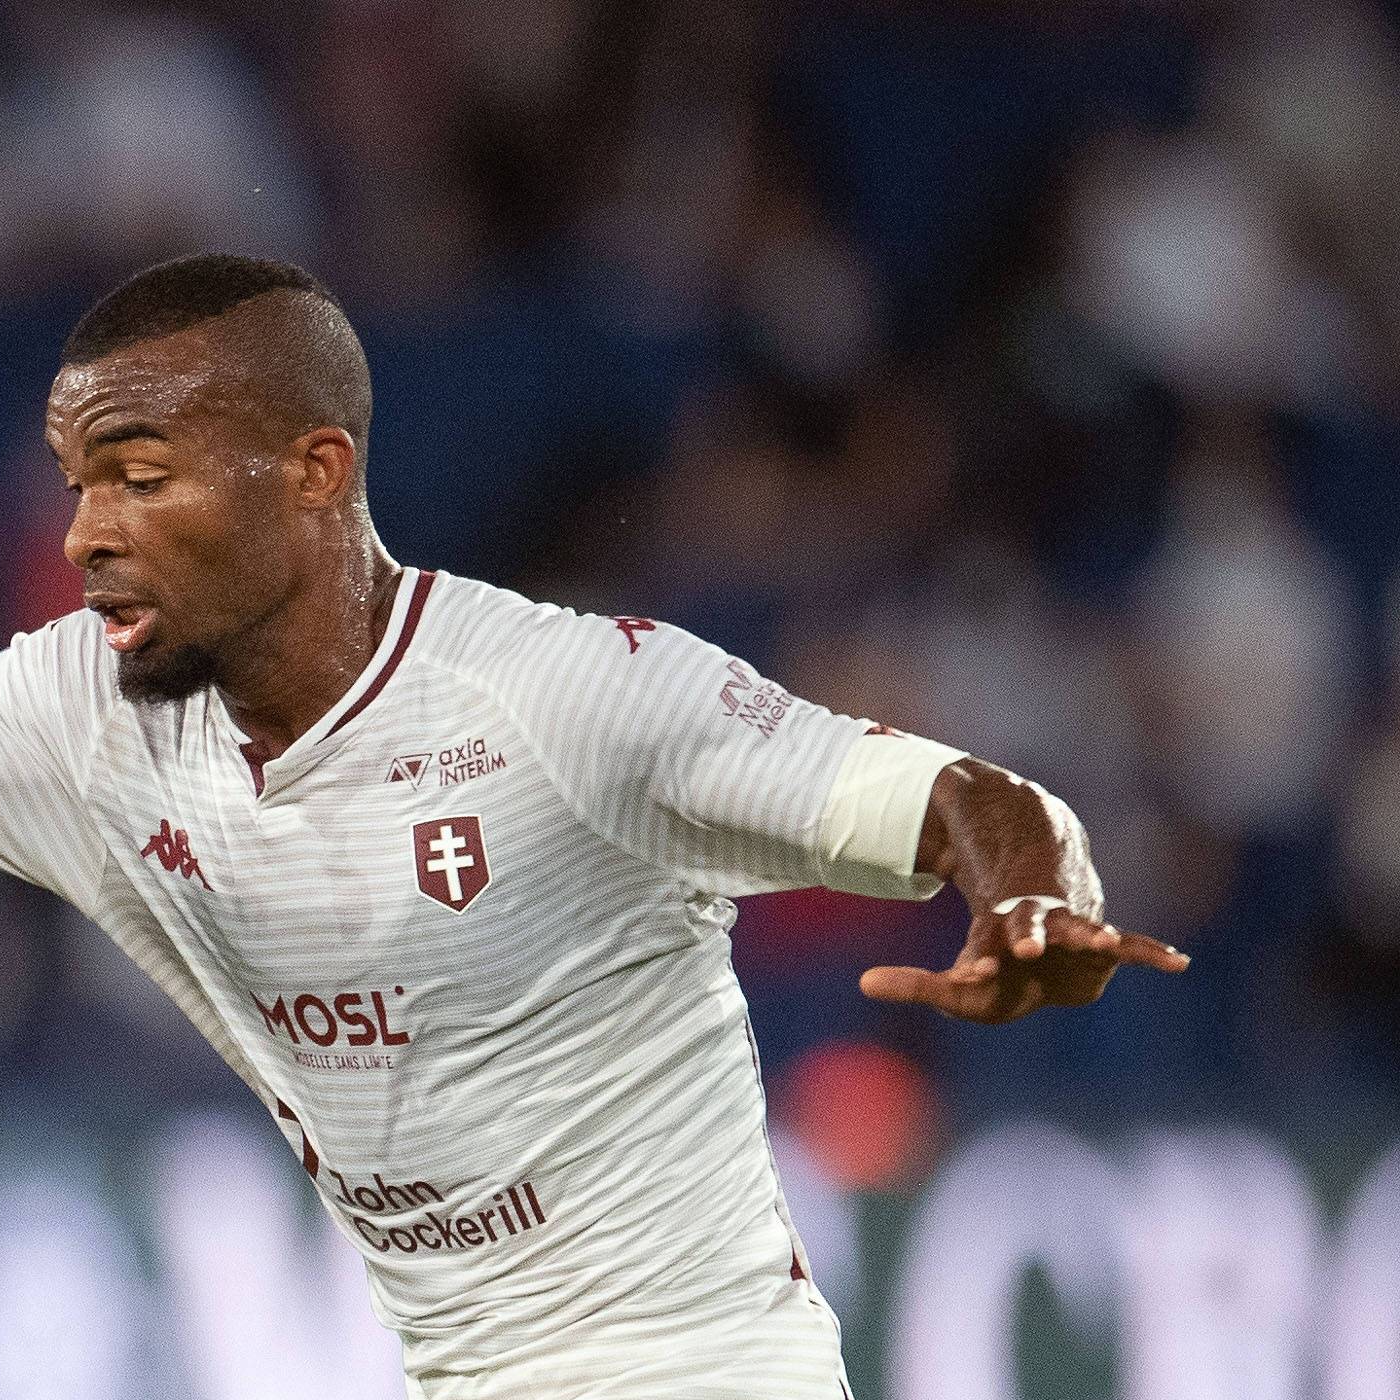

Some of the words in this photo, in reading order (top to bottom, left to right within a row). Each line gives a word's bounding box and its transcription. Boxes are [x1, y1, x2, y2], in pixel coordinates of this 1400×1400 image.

[438, 737, 486, 766] axia
[439, 751, 507, 787] INTERIM
[328, 1168, 446, 1212] John
[353, 1181, 547, 1254] Cockerill
